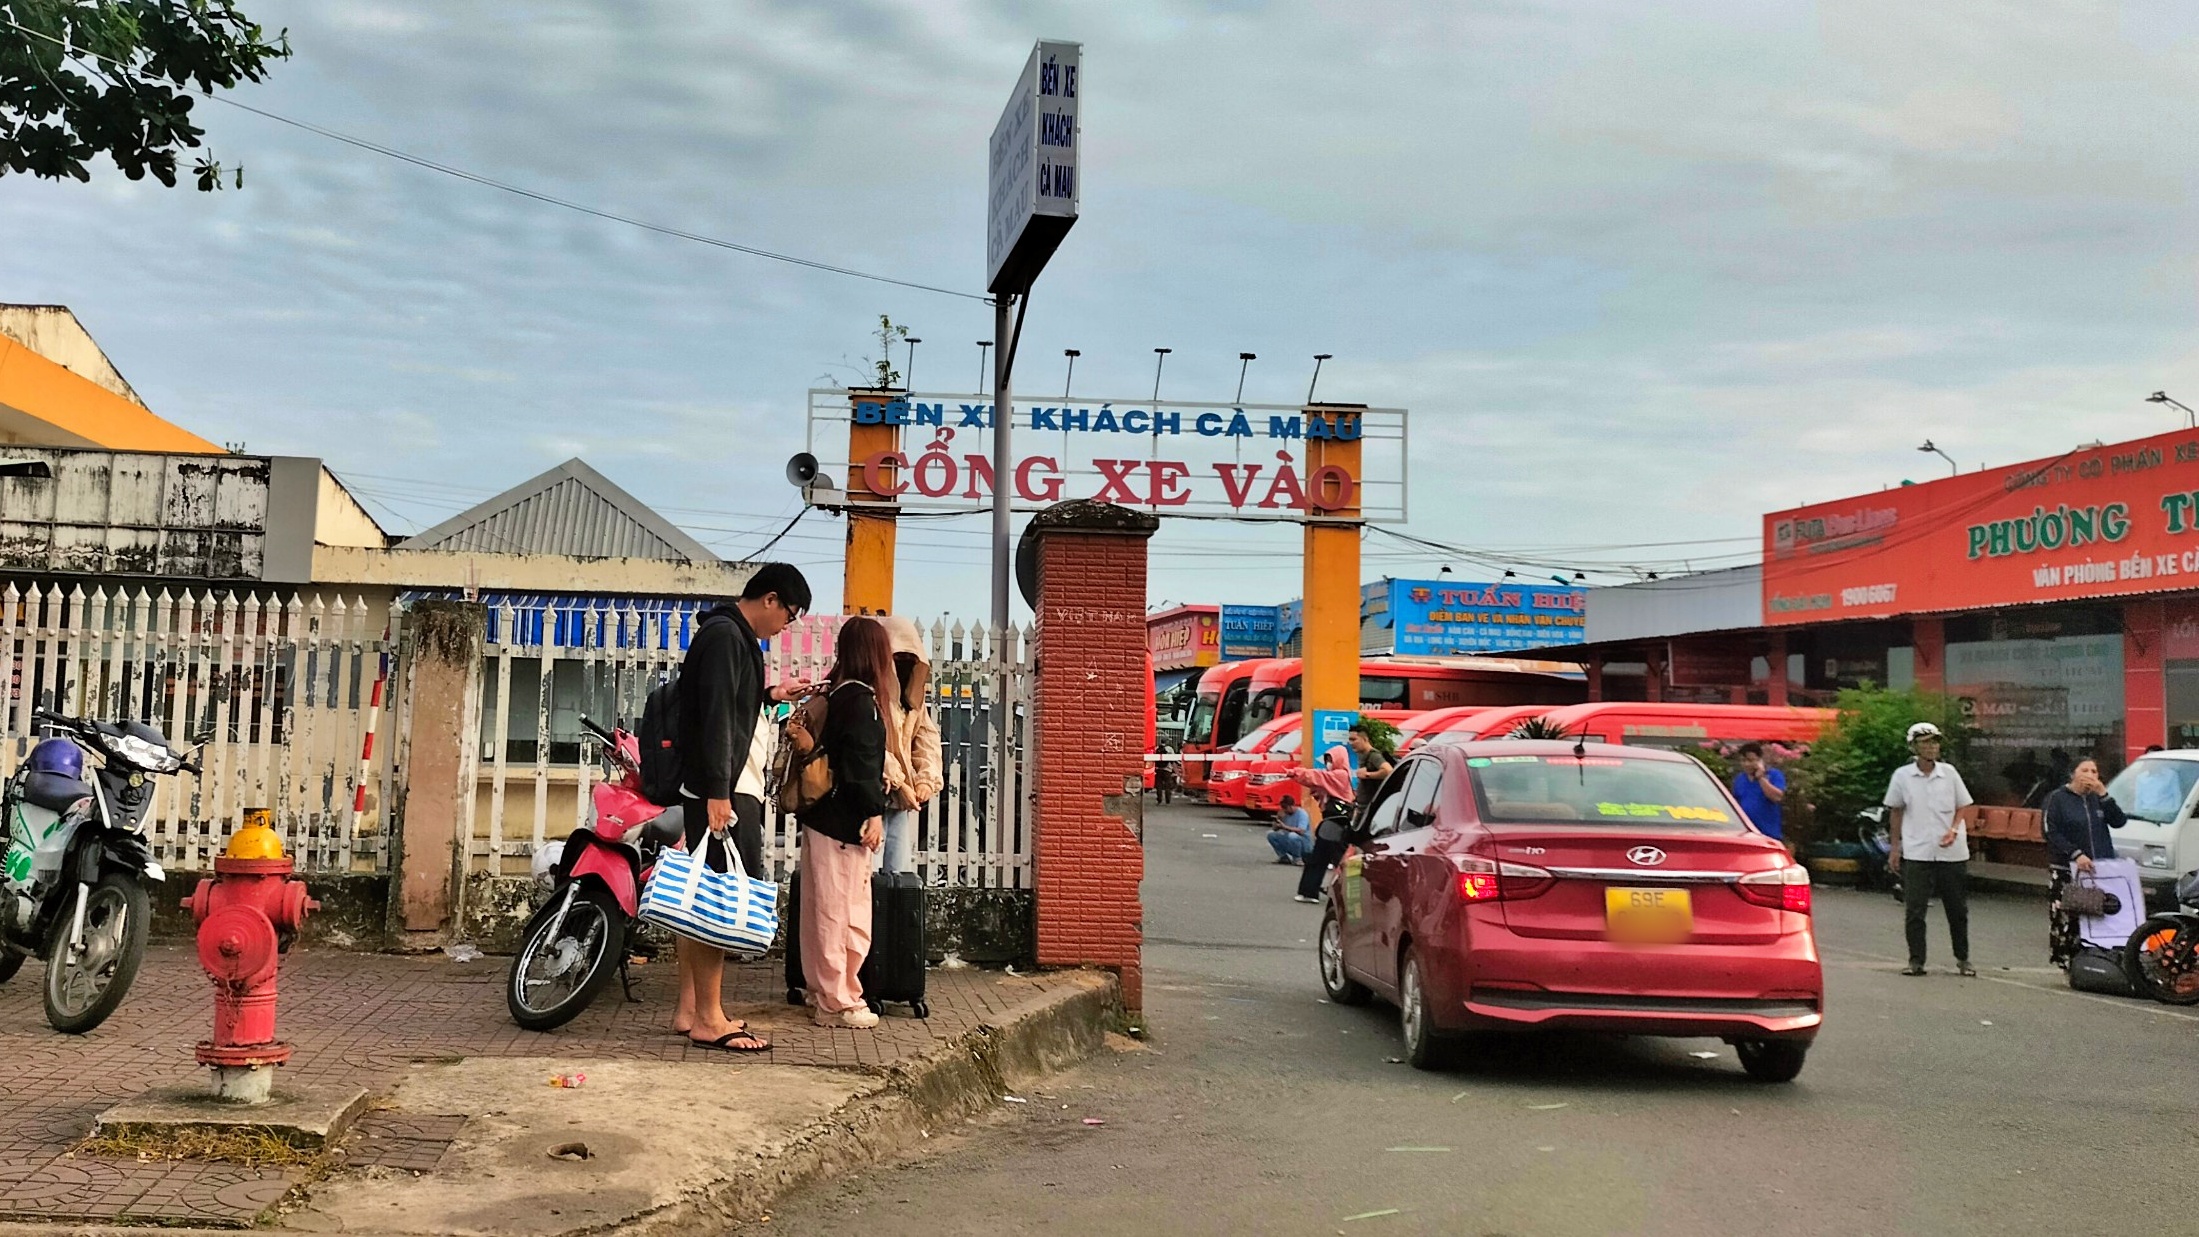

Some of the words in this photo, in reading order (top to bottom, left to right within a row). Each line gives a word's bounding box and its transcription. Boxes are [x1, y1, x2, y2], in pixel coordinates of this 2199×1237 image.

[1041, 54, 1059, 97] BẾN
[1064, 64, 1076, 98] XE
[1041, 107, 1073, 148] KHÁCH
[1040, 156, 1051, 197] CÀ
[1054, 165, 1074, 199] MAU
[856, 391, 943, 427] BẾN
[1031, 403, 1181, 435] KHÁCH
[1196, 407, 1254, 438] CÀ
[1269, 415, 1363, 441] MAU
[864, 427, 1065, 502] CỔNG
[1091, 458, 1193, 506] XE
[1212, 449, 1354, 511] VÀO
[2054, 466, 2074, 483] TY
[2174, 441, 2199, 462] XE
[1967, 502, 2132, 560] PHƯƠNG
[2033, 563, 2061, 588] VĂN
[2063, 557, 2116, 585] PHÒNG
[2119, 550, 2153, 580] BẾN
[2156, 553, 2179, 576] XE
[1438, 582, 1522, 607] TUẤN
[1630, 891, 1666, 909] 69E
